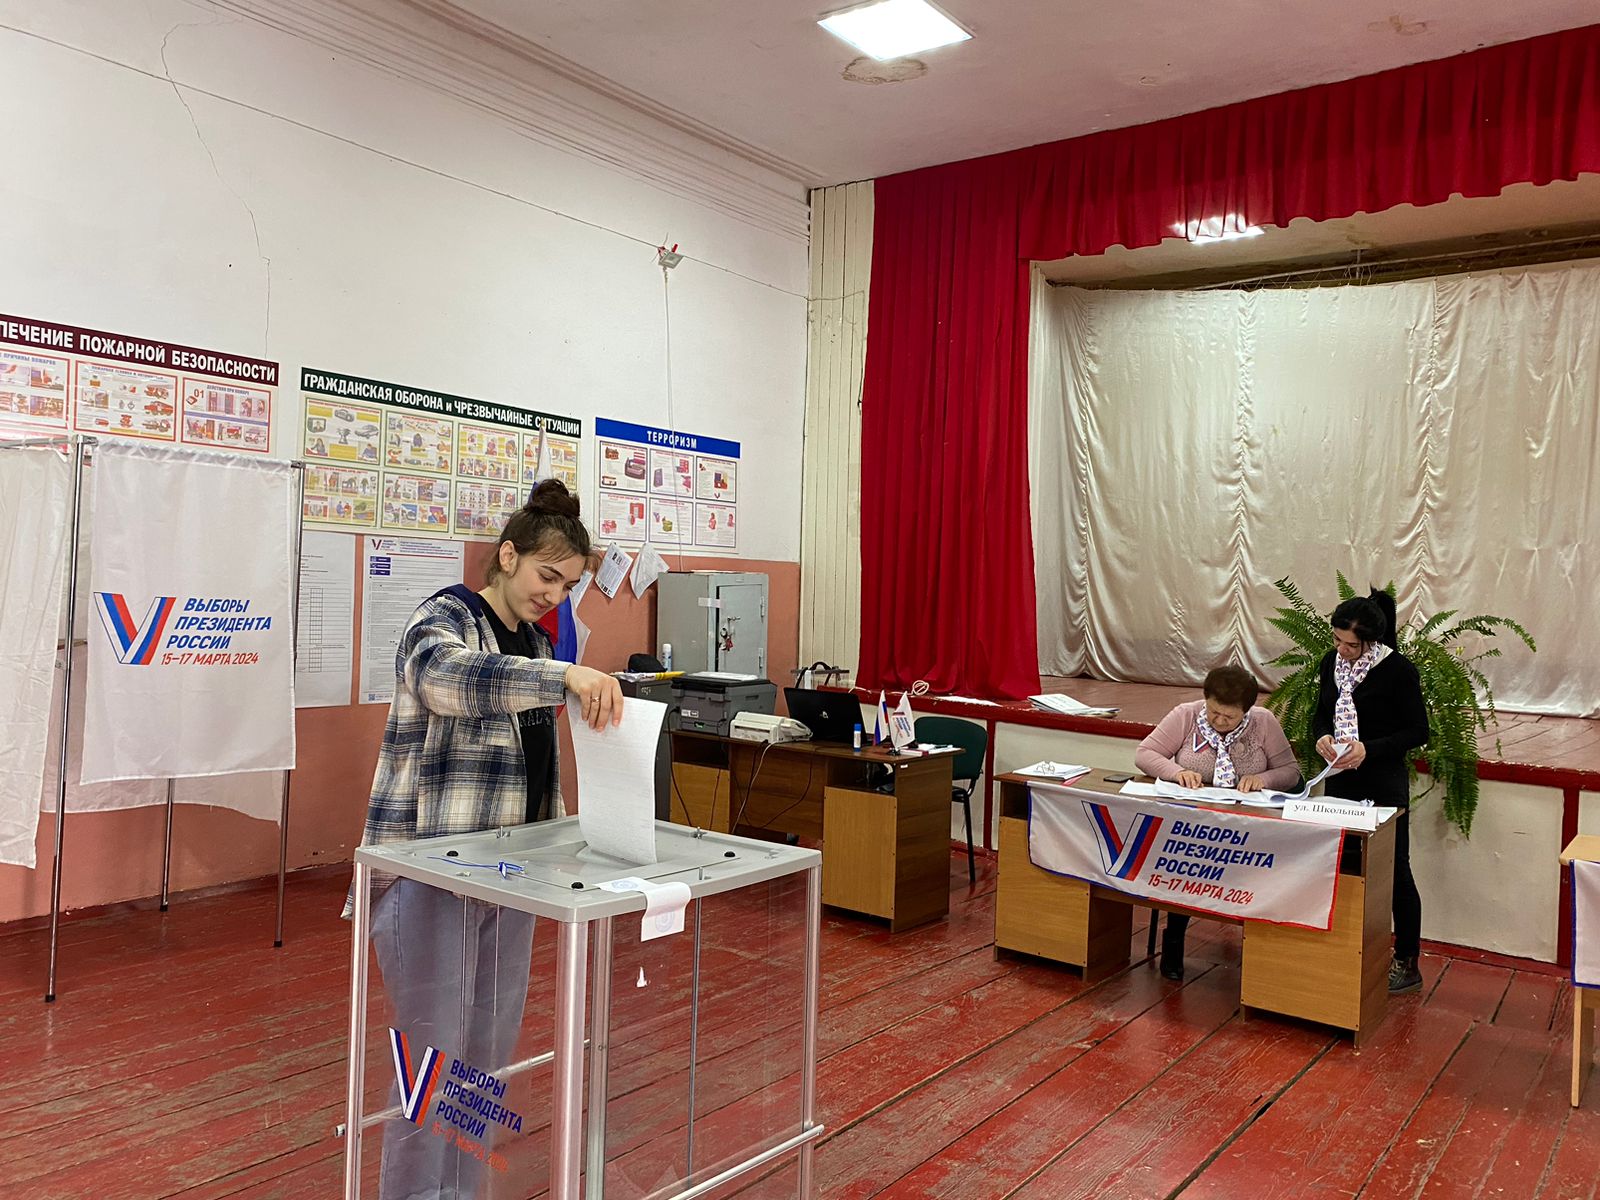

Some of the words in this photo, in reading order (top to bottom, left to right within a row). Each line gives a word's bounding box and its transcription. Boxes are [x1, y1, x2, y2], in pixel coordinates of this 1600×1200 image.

[80, 334, 165, 364] ПОЖАРНОЙ
[172, 350, 275, 382] БЕЗОПАСНОСТИ
[194, 388, 204, 398] 01
[304, 373, 392, 401] ГРАЖДАНСКАЯ
[395, 390, 443, 410] ОБОРОНА
[454, 400, 533, 427] ЧРЕЗВЫЧАЙНЫЕ
[647, 431, 697, 449] ТЕРРОРИЗМ
[184, 598, 250, 613] ВЫБОРЫ
[174, 616, 272, 632] ПРЕЗИДЕНТА
[166, 635, 231, 649] РОССИИ
[192, 653, 231, 665] МАРТА
[232, 652, 259, 665] 2024
[1312, 804, 1365, 817] Школьная
[1170, 820, 1249, 846] ВЫБОРЫ
[1162, 838, 1275, 870] ПРЕЗИДЕНТА
[1154, 858, 1225, 882] РОССИИ
[1181, 877, 1223, 900] МАРТА
[1223, 888, 1255, 905] 2024
[450, 1059, 506, 1099] ВЫБОРЫ
[443, 1080, 523, 1133] ПРЕЗИДЕНТА
[436, 1101, 487, 1139] РОССИИ
